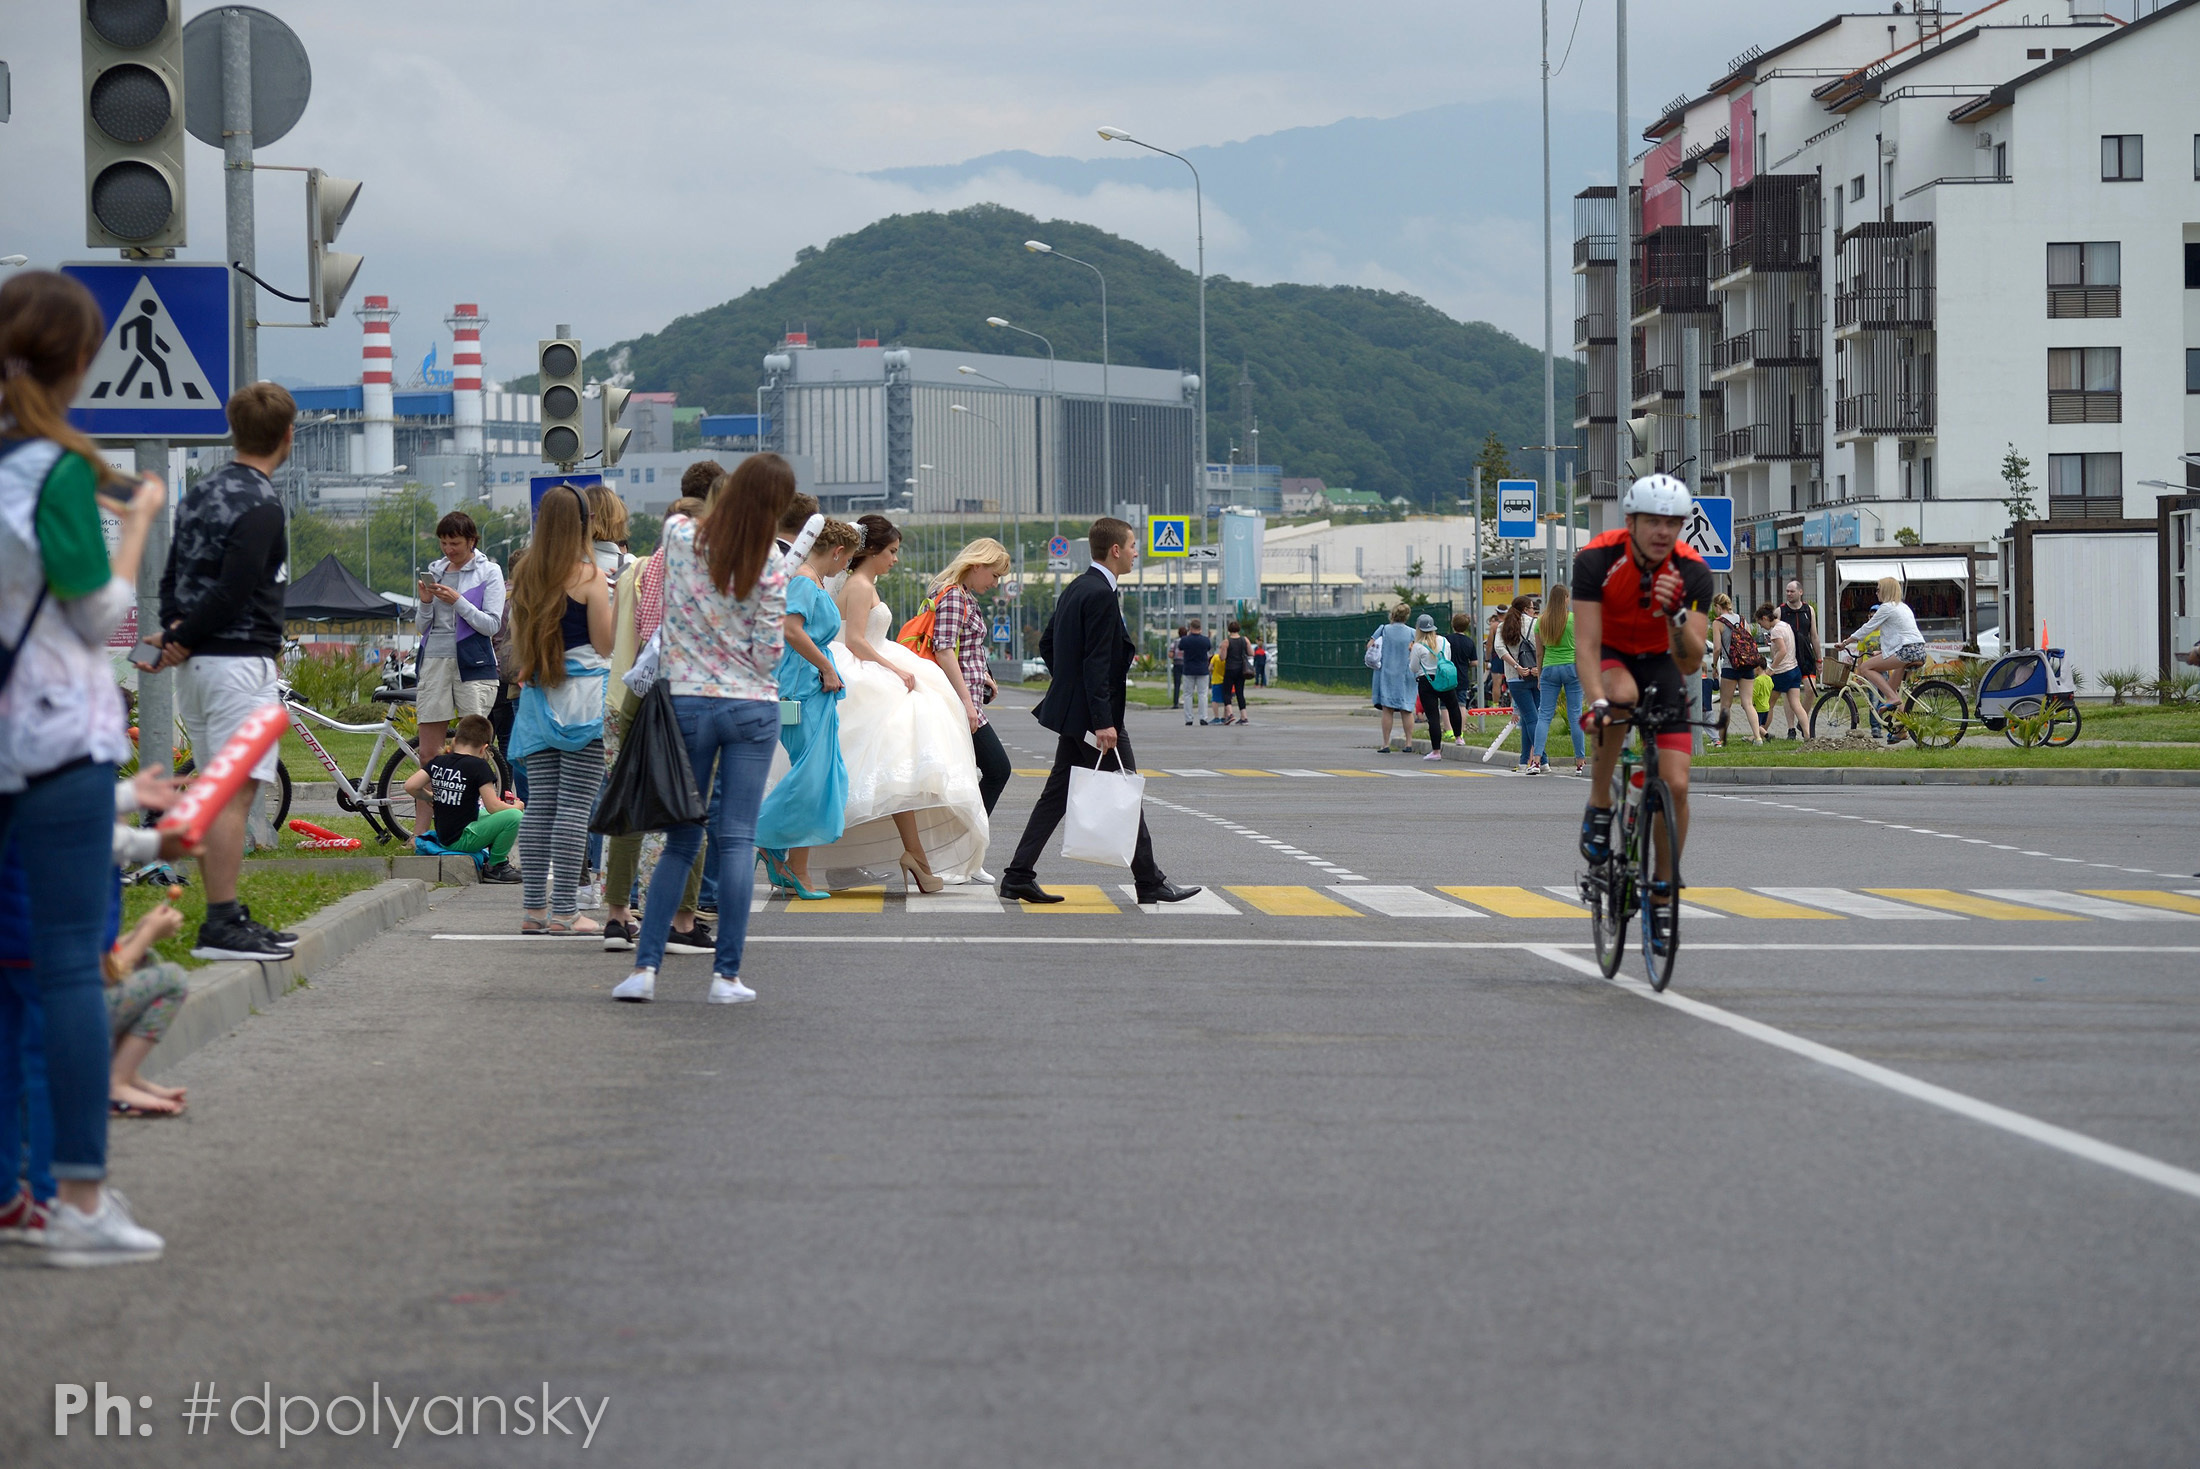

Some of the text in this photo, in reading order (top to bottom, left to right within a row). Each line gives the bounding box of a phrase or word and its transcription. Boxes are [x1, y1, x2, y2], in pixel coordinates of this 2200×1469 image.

[641, 665, 656, 682] CH
[293, 723, 336, 772] CORTO
[430, 764, 467, 783] ПАПА-
